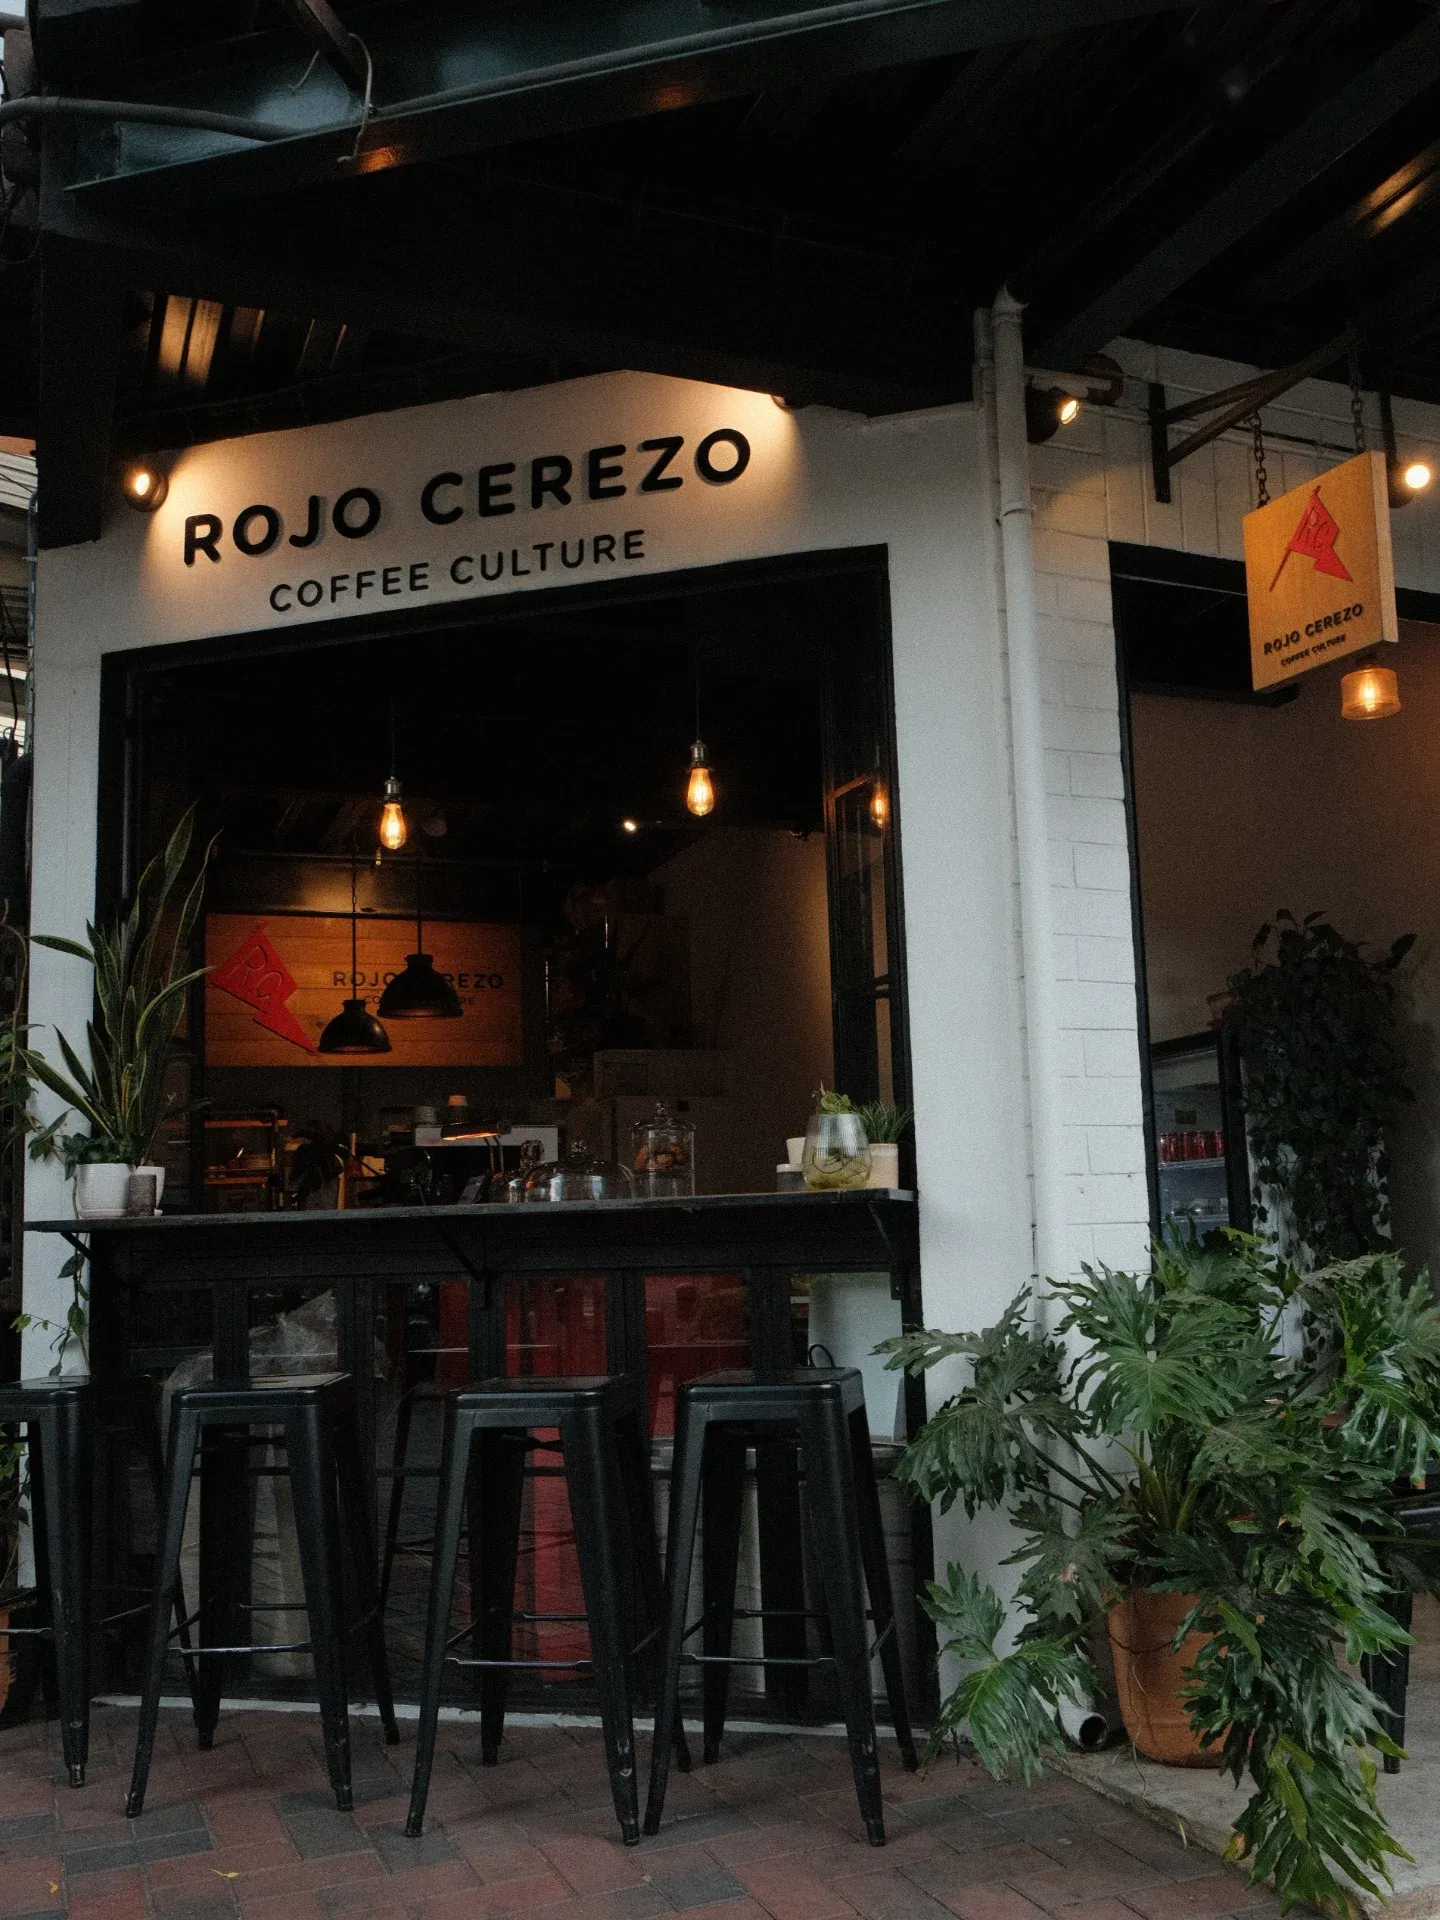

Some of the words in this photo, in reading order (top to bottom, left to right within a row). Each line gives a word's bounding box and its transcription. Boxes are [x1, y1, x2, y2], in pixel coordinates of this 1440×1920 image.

[182, 488, 382, 567] ROJO
[421, 428, 751, 525] CEREZO
[269, 562, 430, 613] COFFEE
[450, 528, 645, 585] CULTURE
[1264, 631, 1300, 655] ROJO
[1305, 603, 1364, 637] CEREZO
[1281, 648, 1310, 666] COFFEE
[1311, 634, 1346, 653] CULTURE
